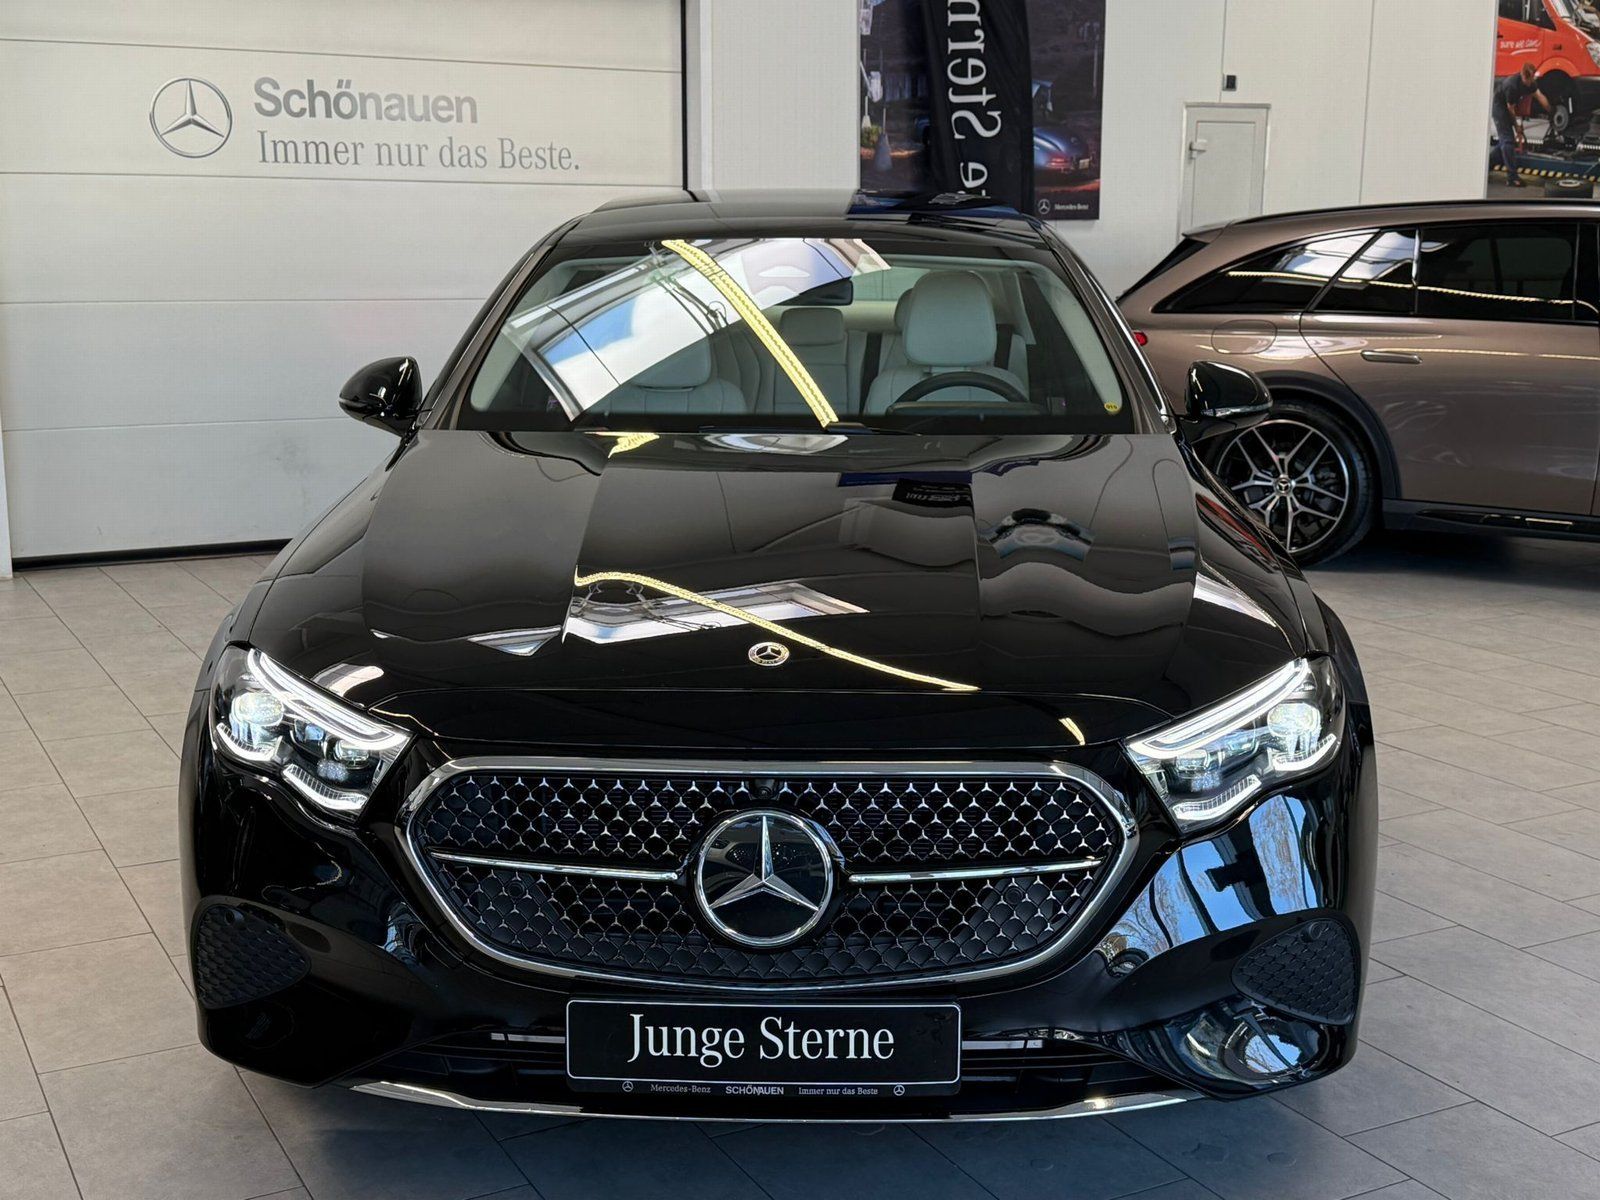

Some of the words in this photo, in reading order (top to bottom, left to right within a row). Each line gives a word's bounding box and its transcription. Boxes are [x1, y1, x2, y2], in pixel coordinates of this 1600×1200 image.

[253, 76, 478, 123] Schönauen
[257, 130, 364, 165] Immer
[374, 141, 428, 167] nur
[439, 136, 488, 169] das
[497, 137, 580, 170] Beste.
[627, 1013, 745, 1068] Junge
[759, 1016, 894, 1059] Sterne
[650, 1084, 711, 1093] Mercedes-Benz
[725, 1084, 784, 1096] SCHÖNAUEN
[798, 1087, 825, 1095] Immer
[842, 1087, 856, 1095] das
[857, 1087, 879, 1095] Beste
